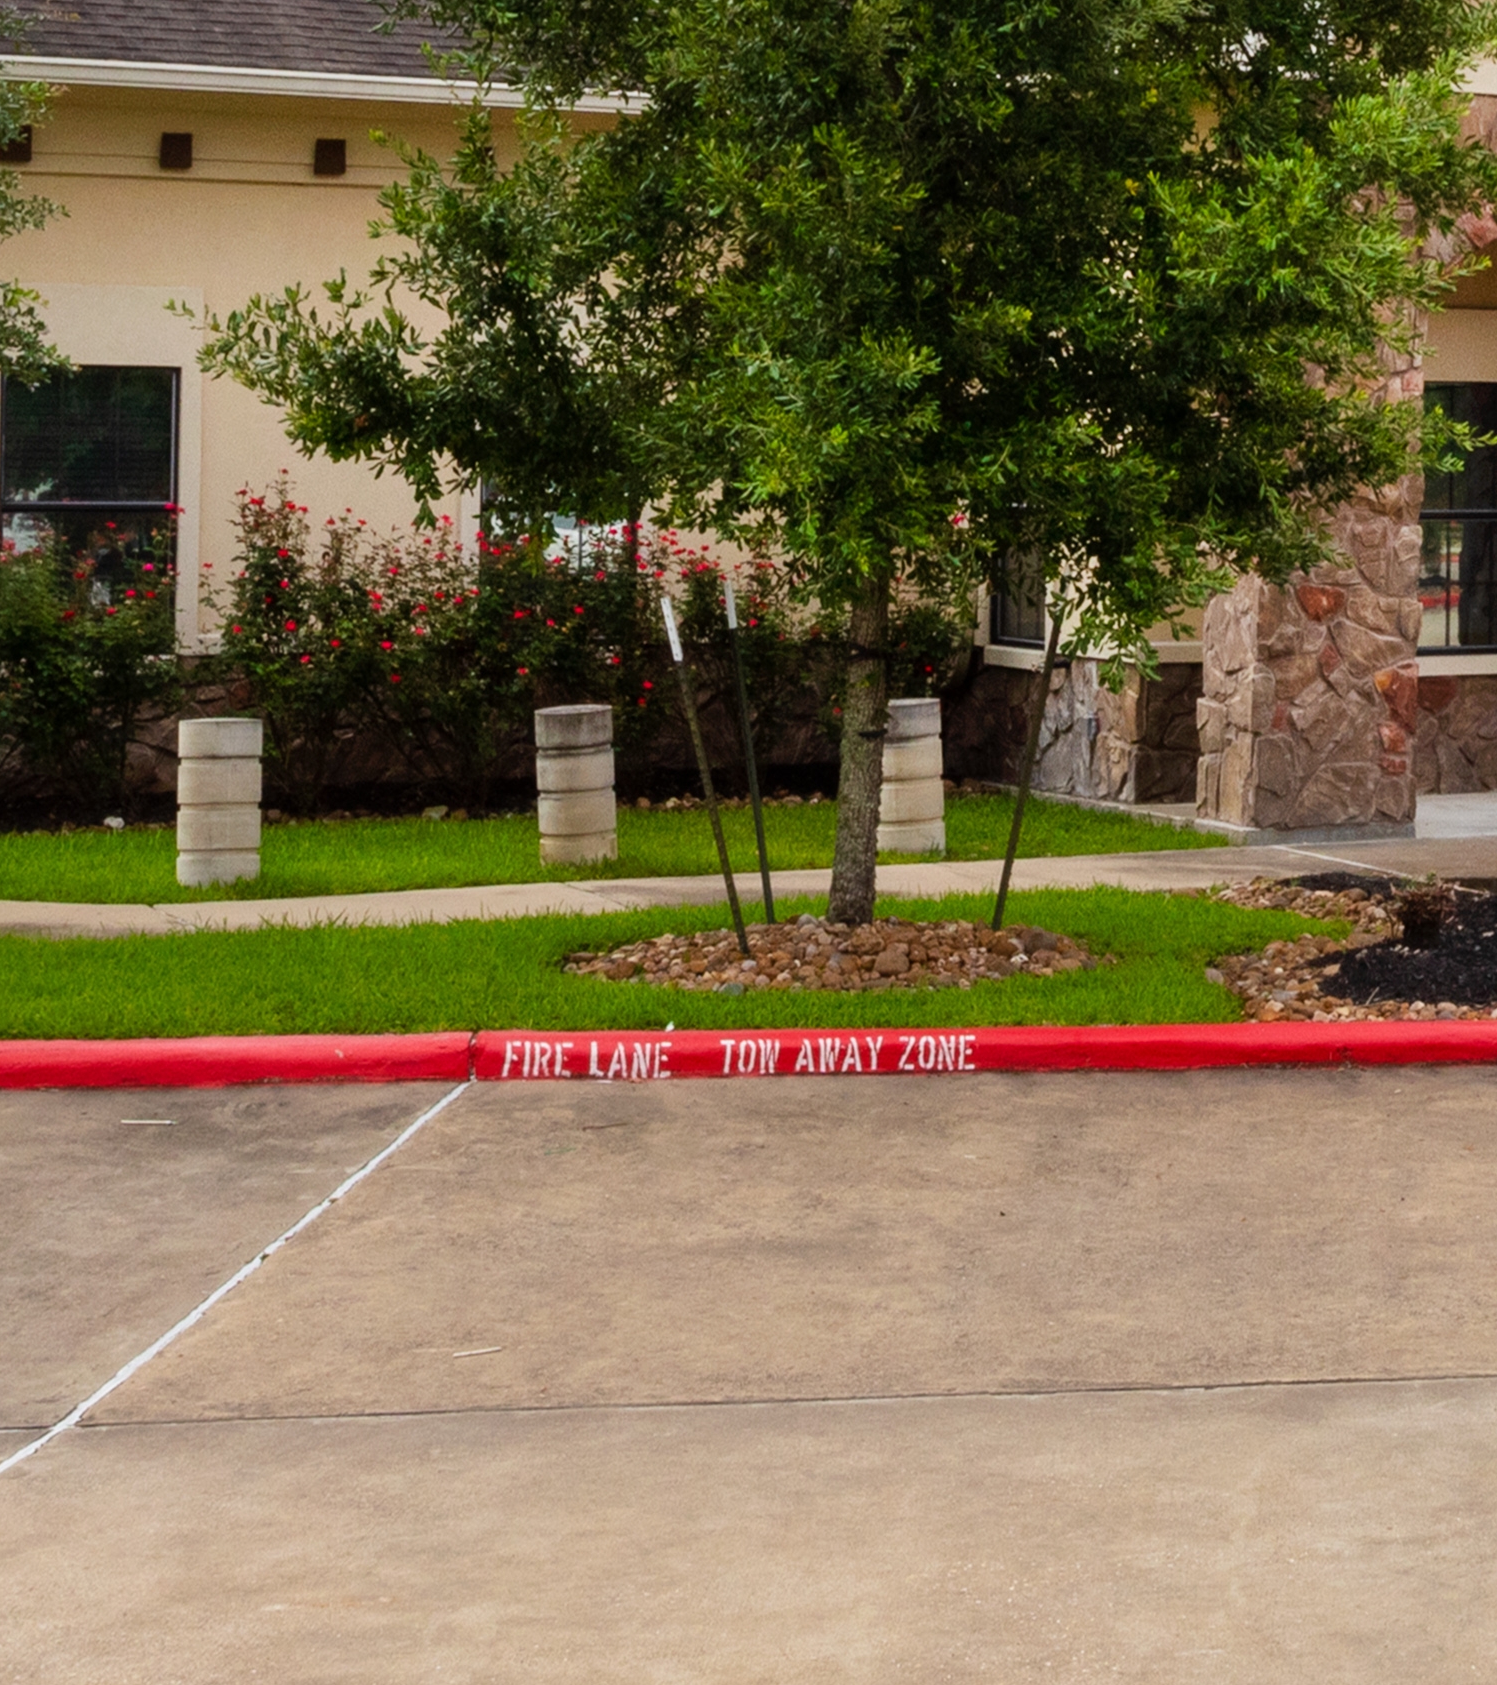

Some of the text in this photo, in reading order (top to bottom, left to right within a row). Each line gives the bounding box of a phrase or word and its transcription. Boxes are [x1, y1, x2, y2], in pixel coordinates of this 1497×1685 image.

[502, 1035, 976, 1078] FIRE LANE TOW AWAY ZONE
